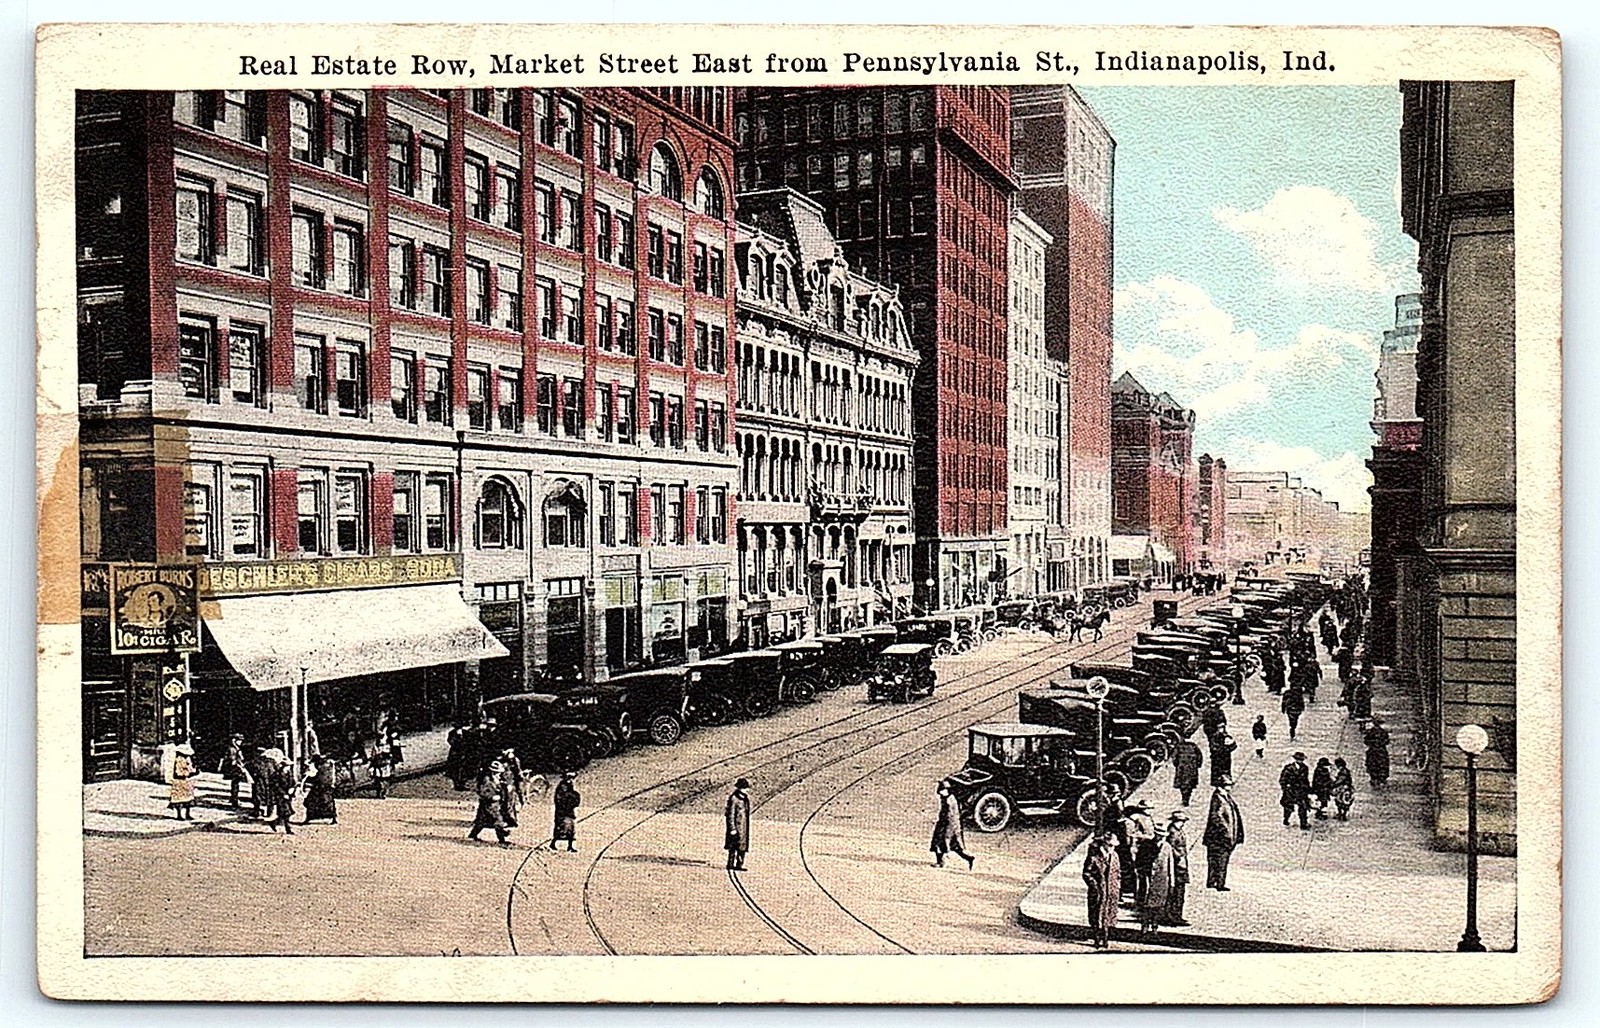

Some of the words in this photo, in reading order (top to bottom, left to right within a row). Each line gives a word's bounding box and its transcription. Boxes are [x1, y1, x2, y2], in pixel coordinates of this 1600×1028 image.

[116, 569, 157, 591] ROBERT
[159, 569, 194, 590] BURNS
[323, 560, 394, 584] CIGARS
[406, 557, 457, 579] SODA
[139, 629, 197, 647] CIGAR
